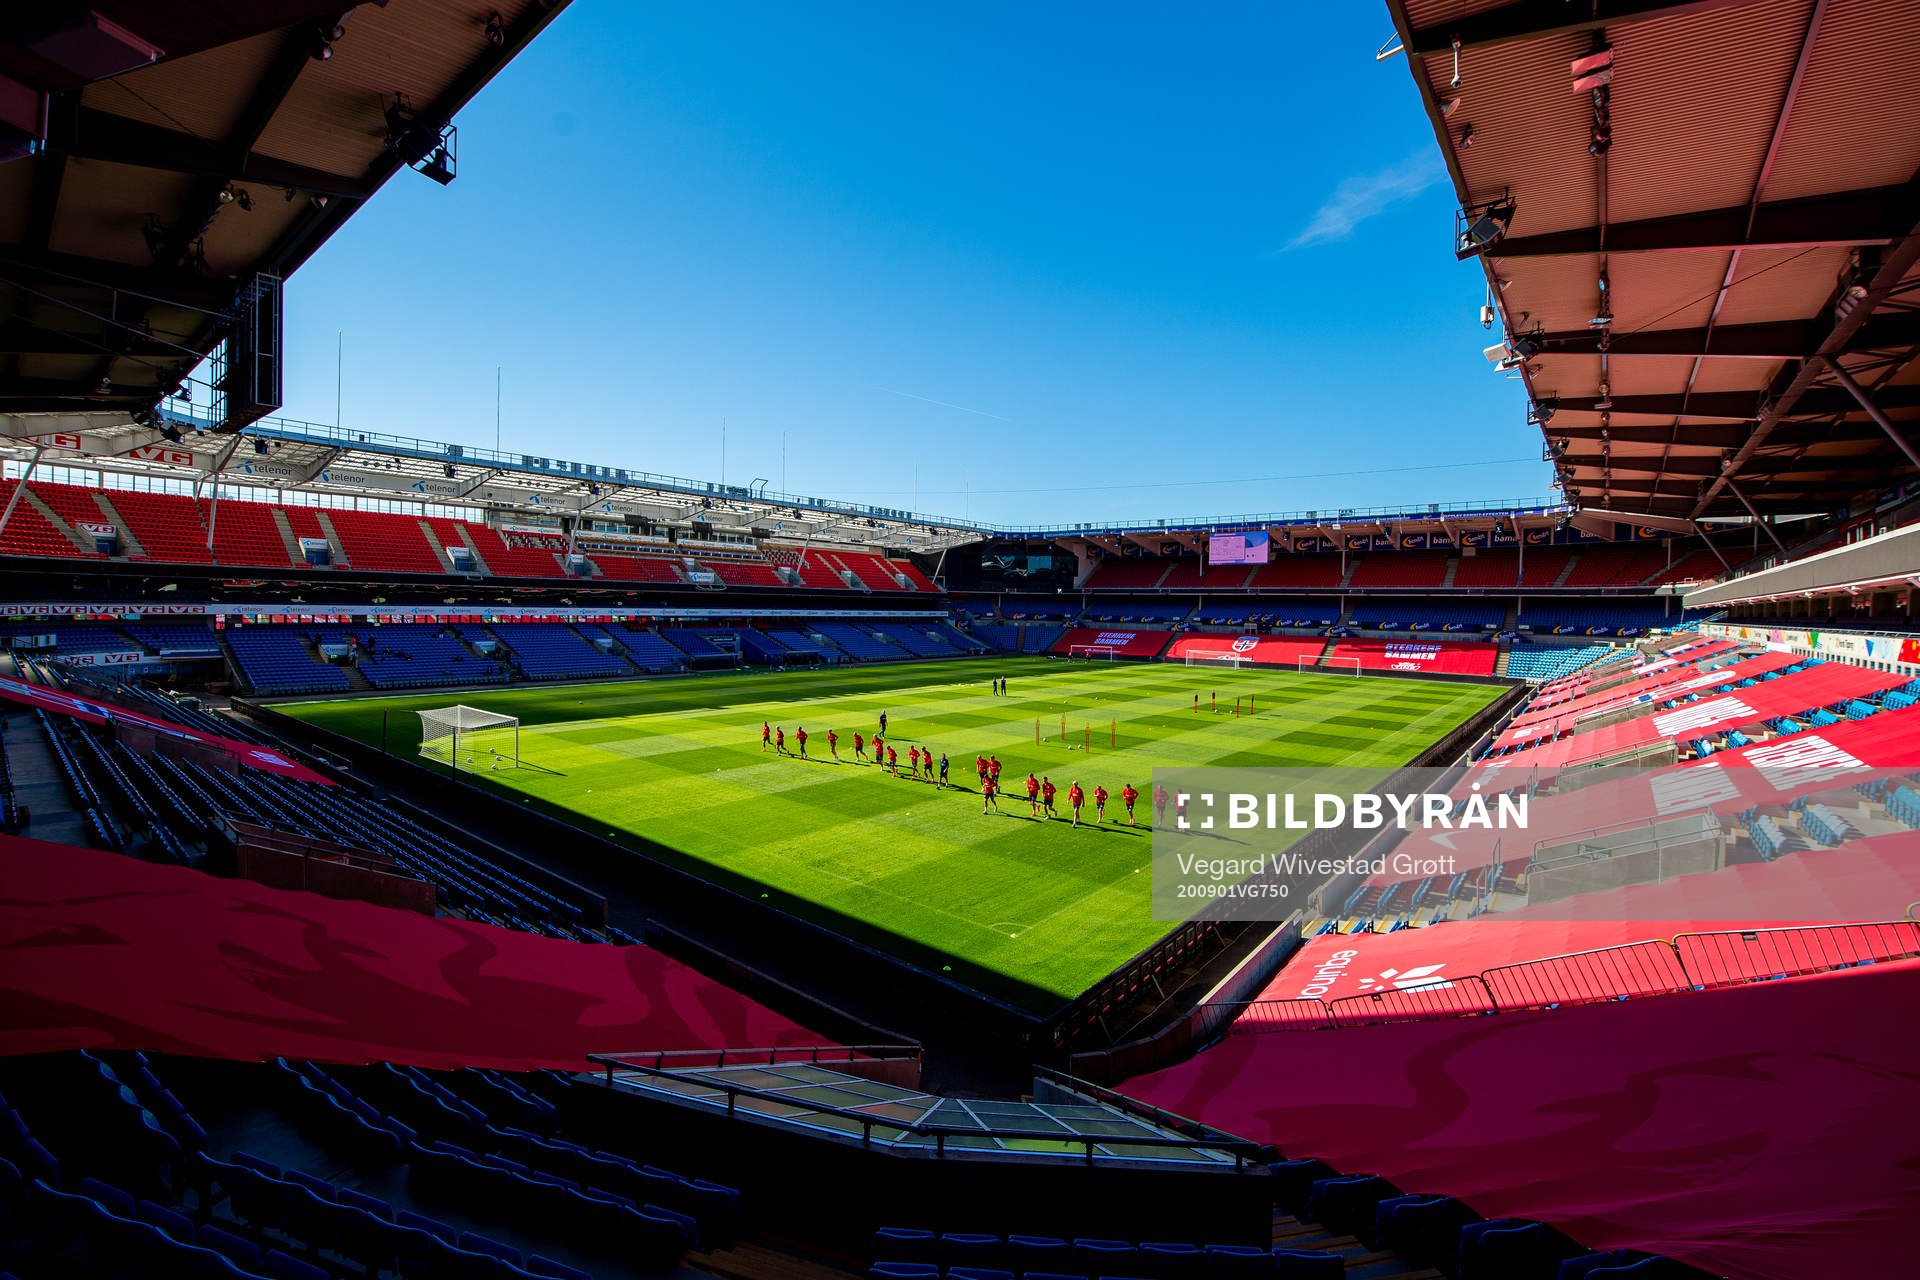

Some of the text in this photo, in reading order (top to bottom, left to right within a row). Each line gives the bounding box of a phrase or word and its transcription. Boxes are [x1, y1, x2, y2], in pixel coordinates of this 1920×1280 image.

[129, 447, 192, 466] VG
[254, 464, 292, 477] telenor
[330, 472, 365, 484] telenor
[425, 483, 456, 493] telenor
[540, 495, 565, 505] telenor
[611, 504, 633, 513] telenor
[82, 523, 115, 534] VG
[21, 605, 49, 614] VG
[53, 605, 87, 614] VG
[92, 605, 126, 614] VG
[129, 605, 165, 614] VG
[169, 605, 206, 614] VG
[1385, 643, 1442, 653] STERKERE
[105, 654, 139, 663] VG
[1384, 651, 1436, 660] SAMMEN
